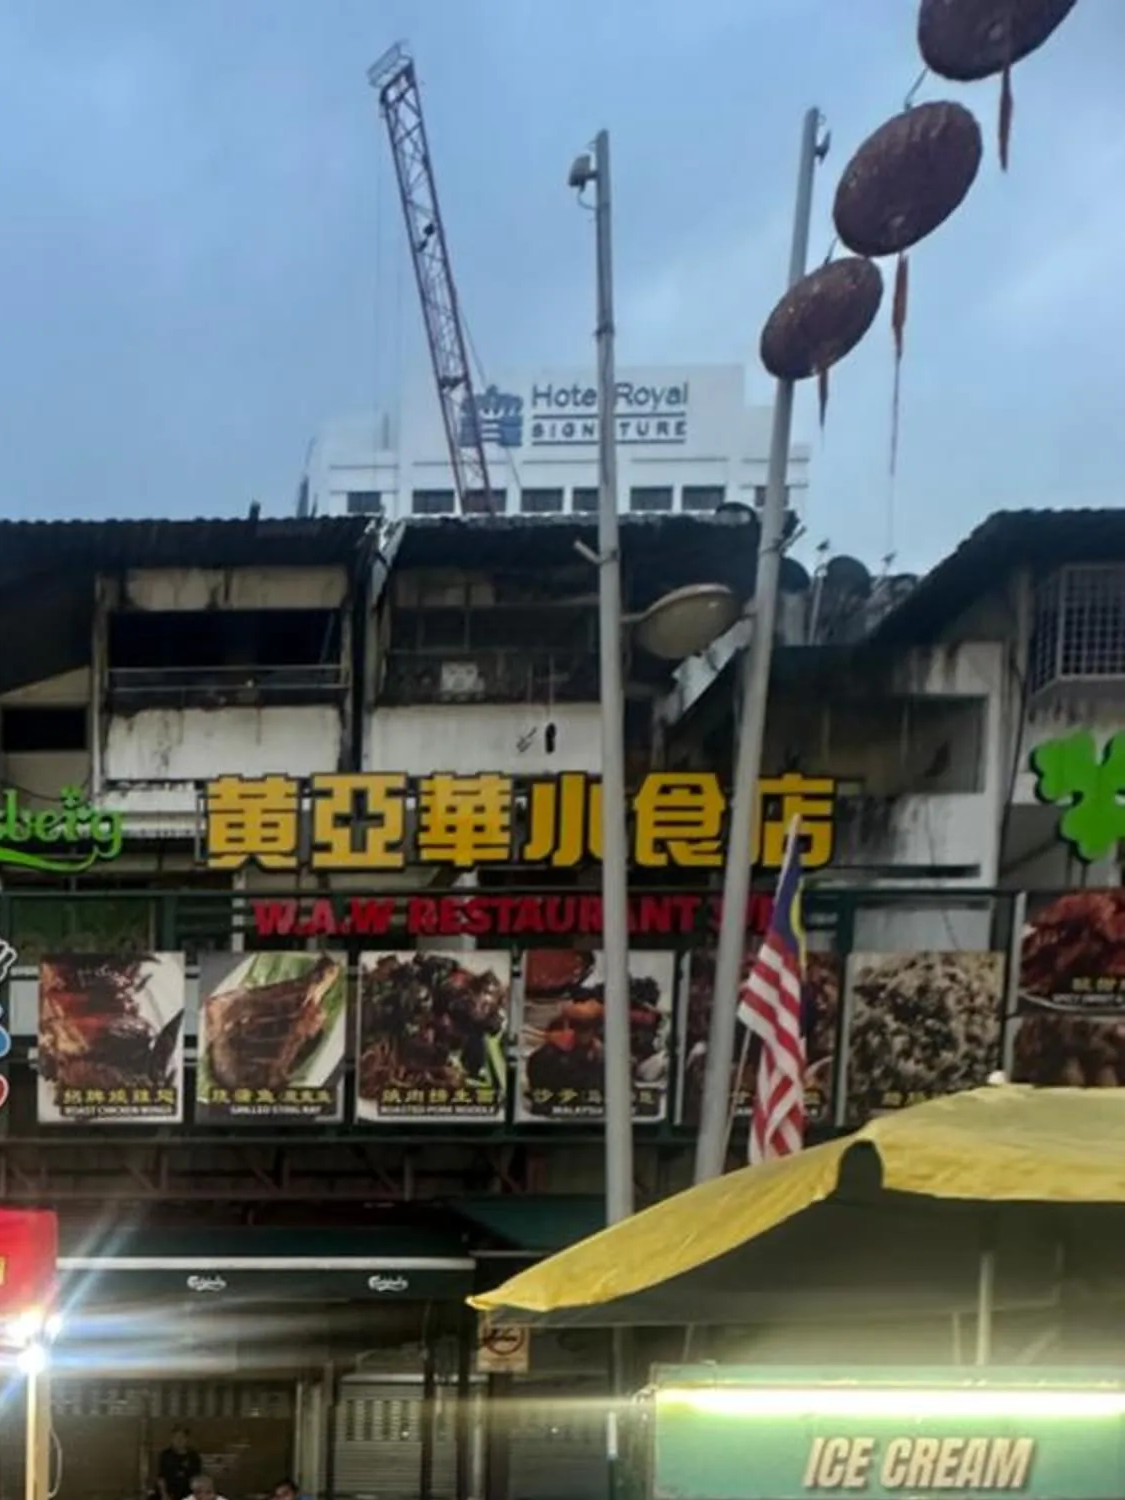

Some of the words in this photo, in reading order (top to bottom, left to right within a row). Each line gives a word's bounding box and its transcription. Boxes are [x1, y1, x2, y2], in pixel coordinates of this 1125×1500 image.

[532, 383, 599, 408] Hote
[615, 382, 689, 411] Royal
[531, 421, 687, 439] SIGNTURE
[802, 1437, 875, 1488] ICE
[879, 1437, 1036, 1488] CREAM
